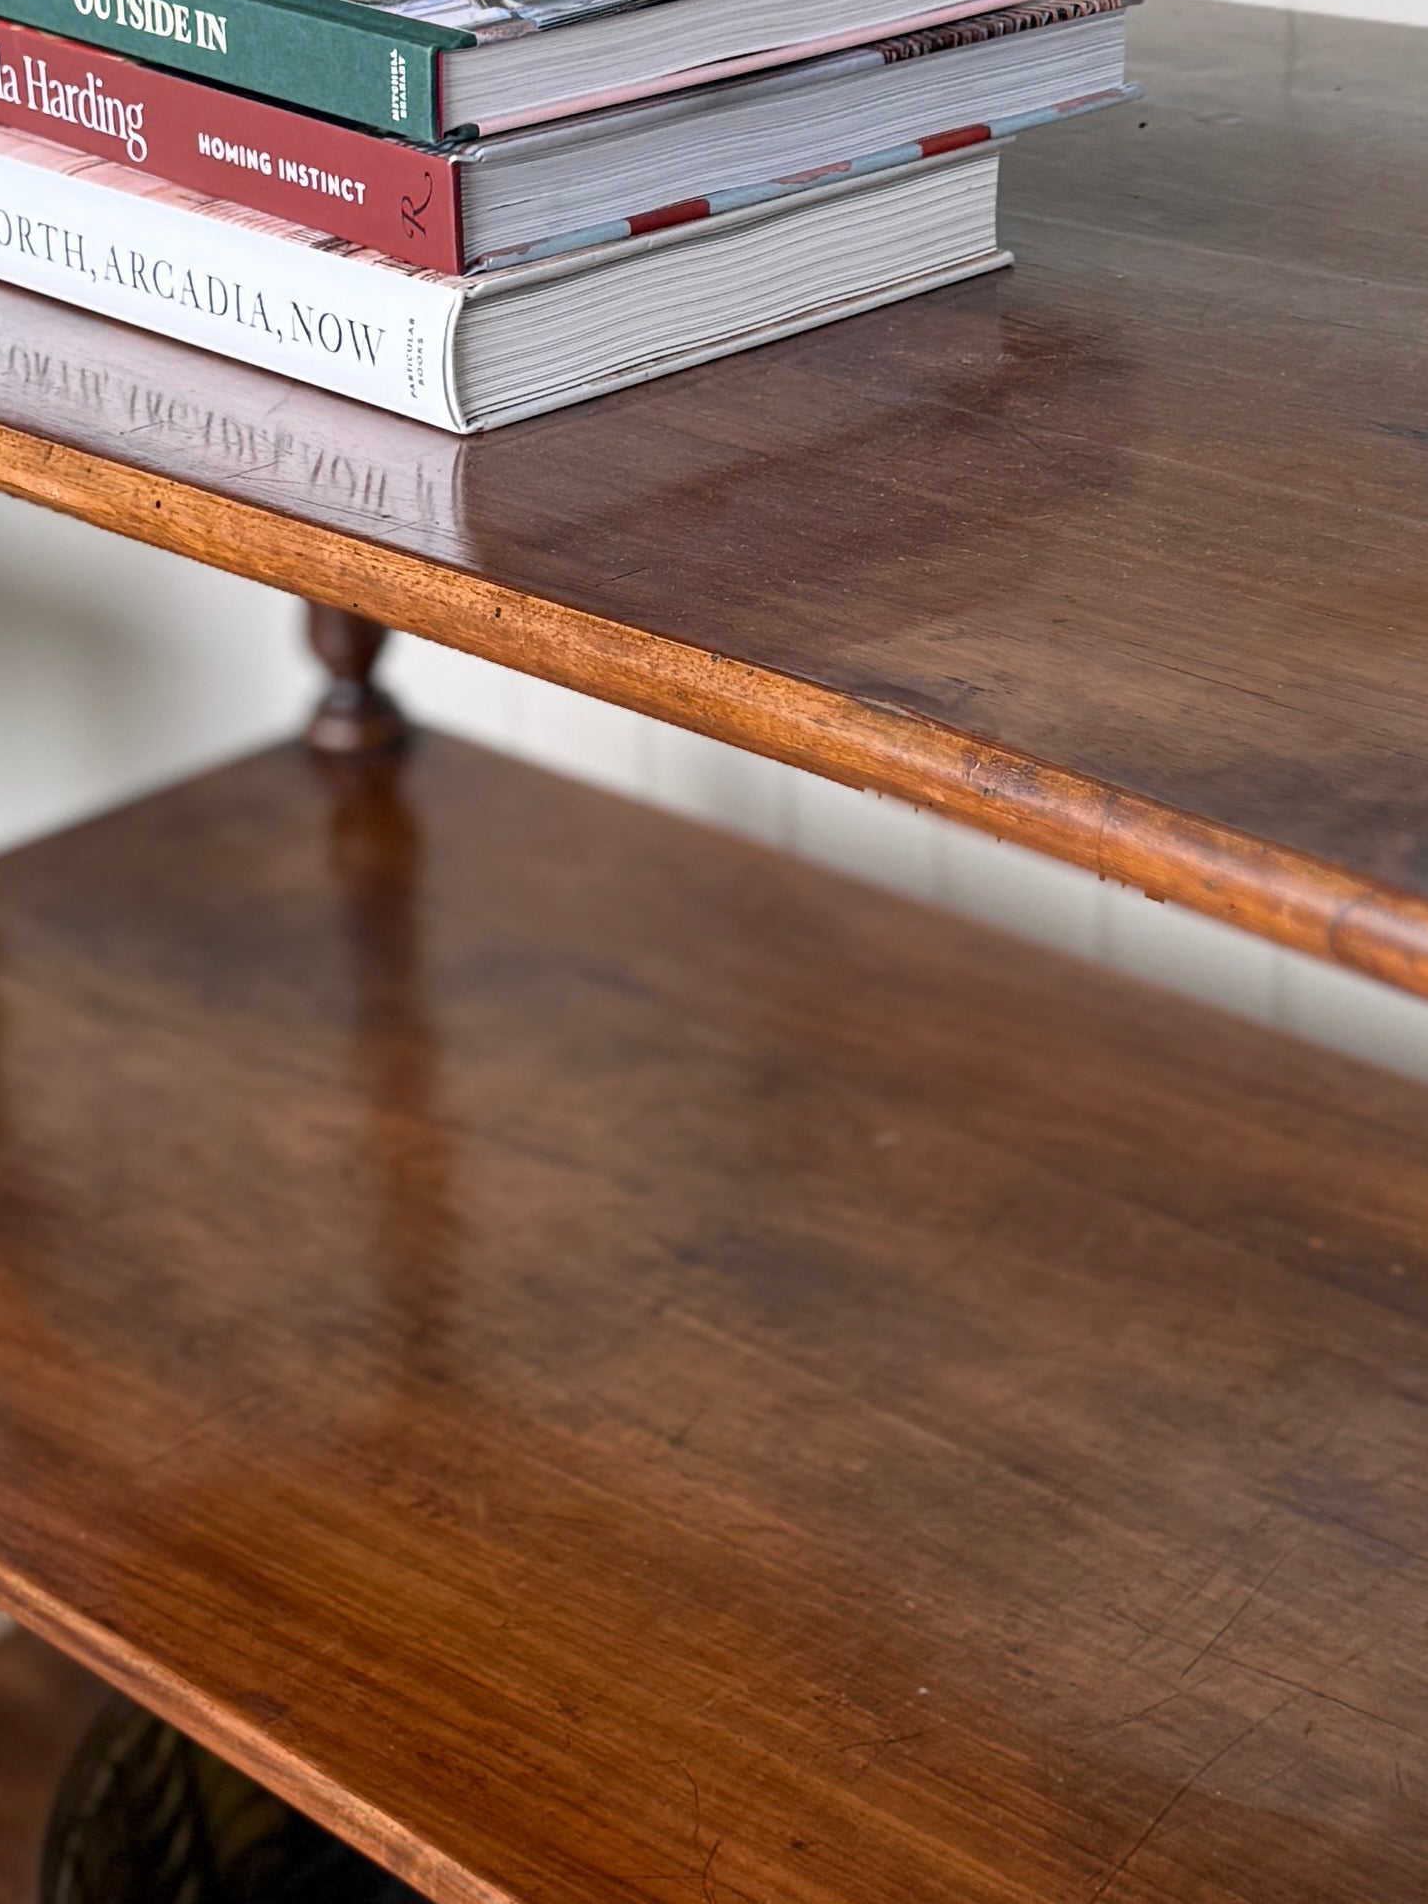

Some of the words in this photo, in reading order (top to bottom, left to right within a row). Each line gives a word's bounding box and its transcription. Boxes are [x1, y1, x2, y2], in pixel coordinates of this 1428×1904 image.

[194, 9, 228, 54] IN
[22, 54, 149, 163] Harding
[197, 132, 273, 176] HOMING
[278, 157, 367, 205] INSTINCT
[104, 244, 284, 344] ARCADIA,
[289, 299, 387, 368] NOW
